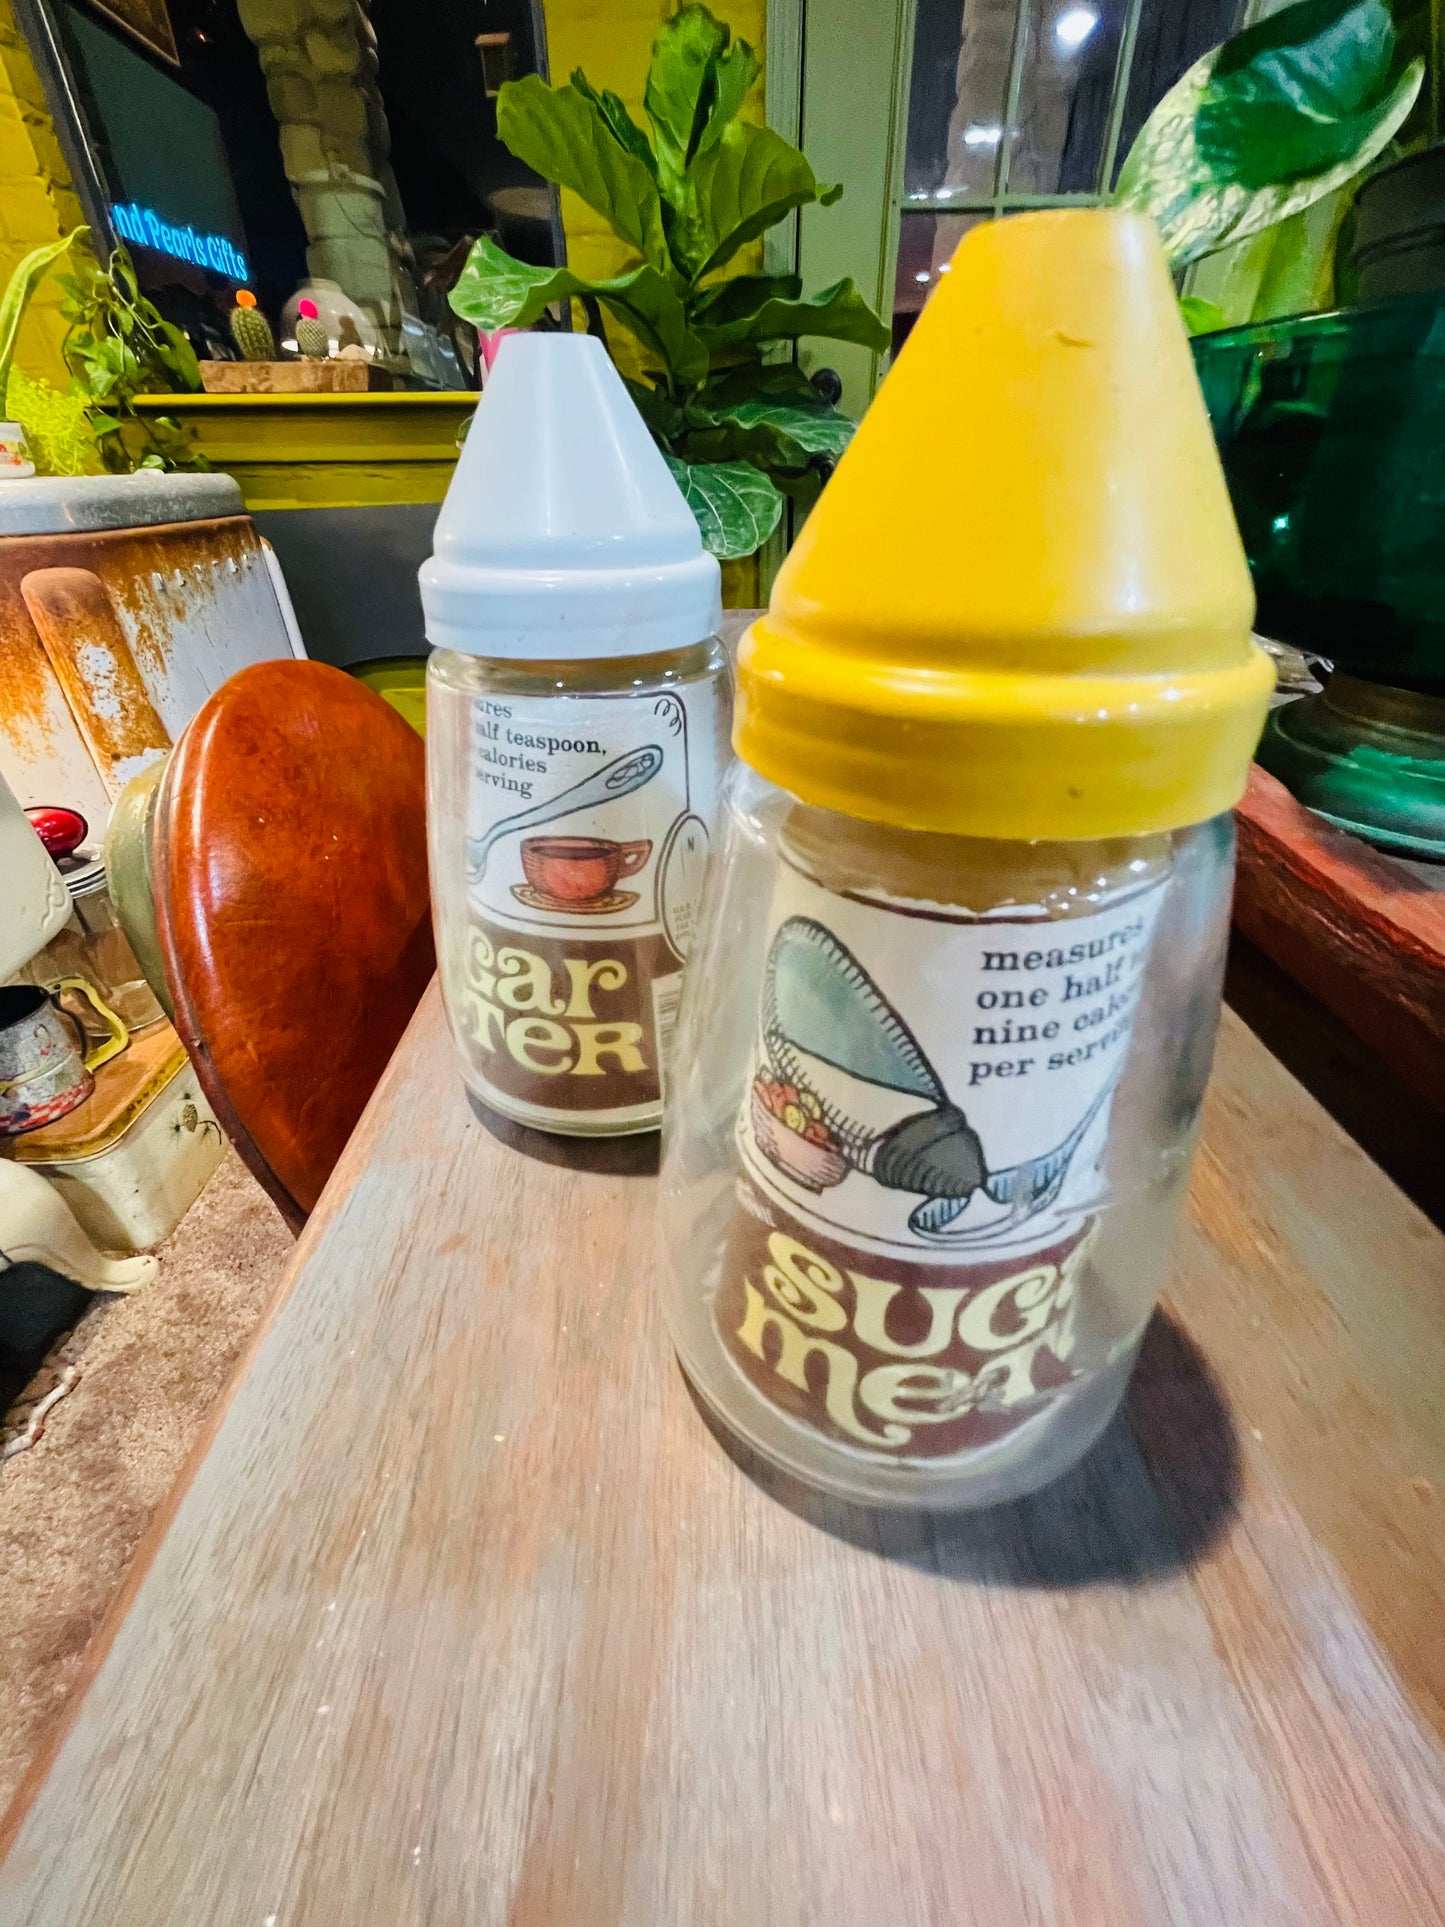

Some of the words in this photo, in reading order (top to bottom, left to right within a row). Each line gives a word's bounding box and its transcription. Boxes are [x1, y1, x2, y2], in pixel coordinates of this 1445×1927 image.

[144, 210, 208, 267] Pearls
[506, 727, 607, 757] teaspoon,
[977, 986, 1049, 1010] one
[973, 1018, 1060, 1045] nine
[968, 1058, 1036, 1086] per
[762, 1230, 1098, 1358] SUG
